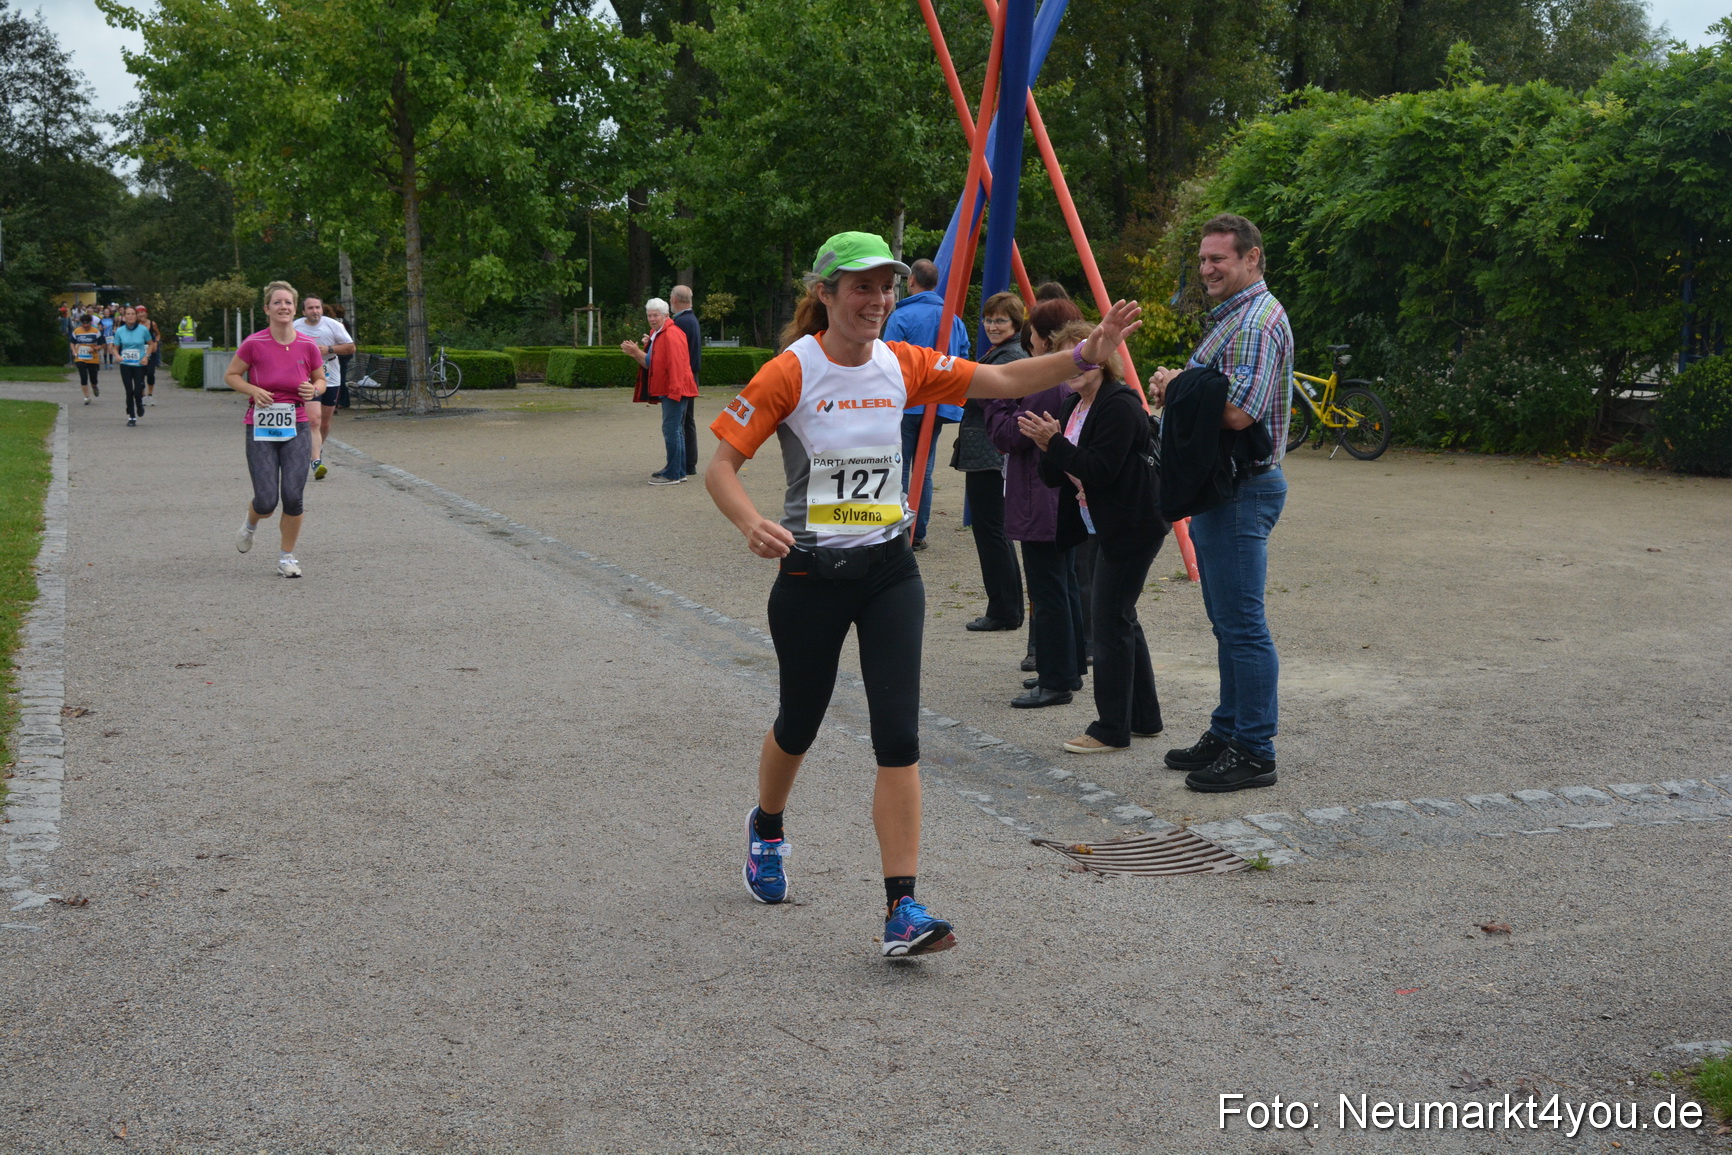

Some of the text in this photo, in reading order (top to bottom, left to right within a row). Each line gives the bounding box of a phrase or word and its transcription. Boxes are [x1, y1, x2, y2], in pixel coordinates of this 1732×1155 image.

[838, 398, 897, 410] KLEBL
[258, 412, 292, 427] 2205
[813, 455, 893, 468] PARTL Neumarkt
[830, 468, 890, 500] 127
[833, 507, 882, 524] Sylvana
